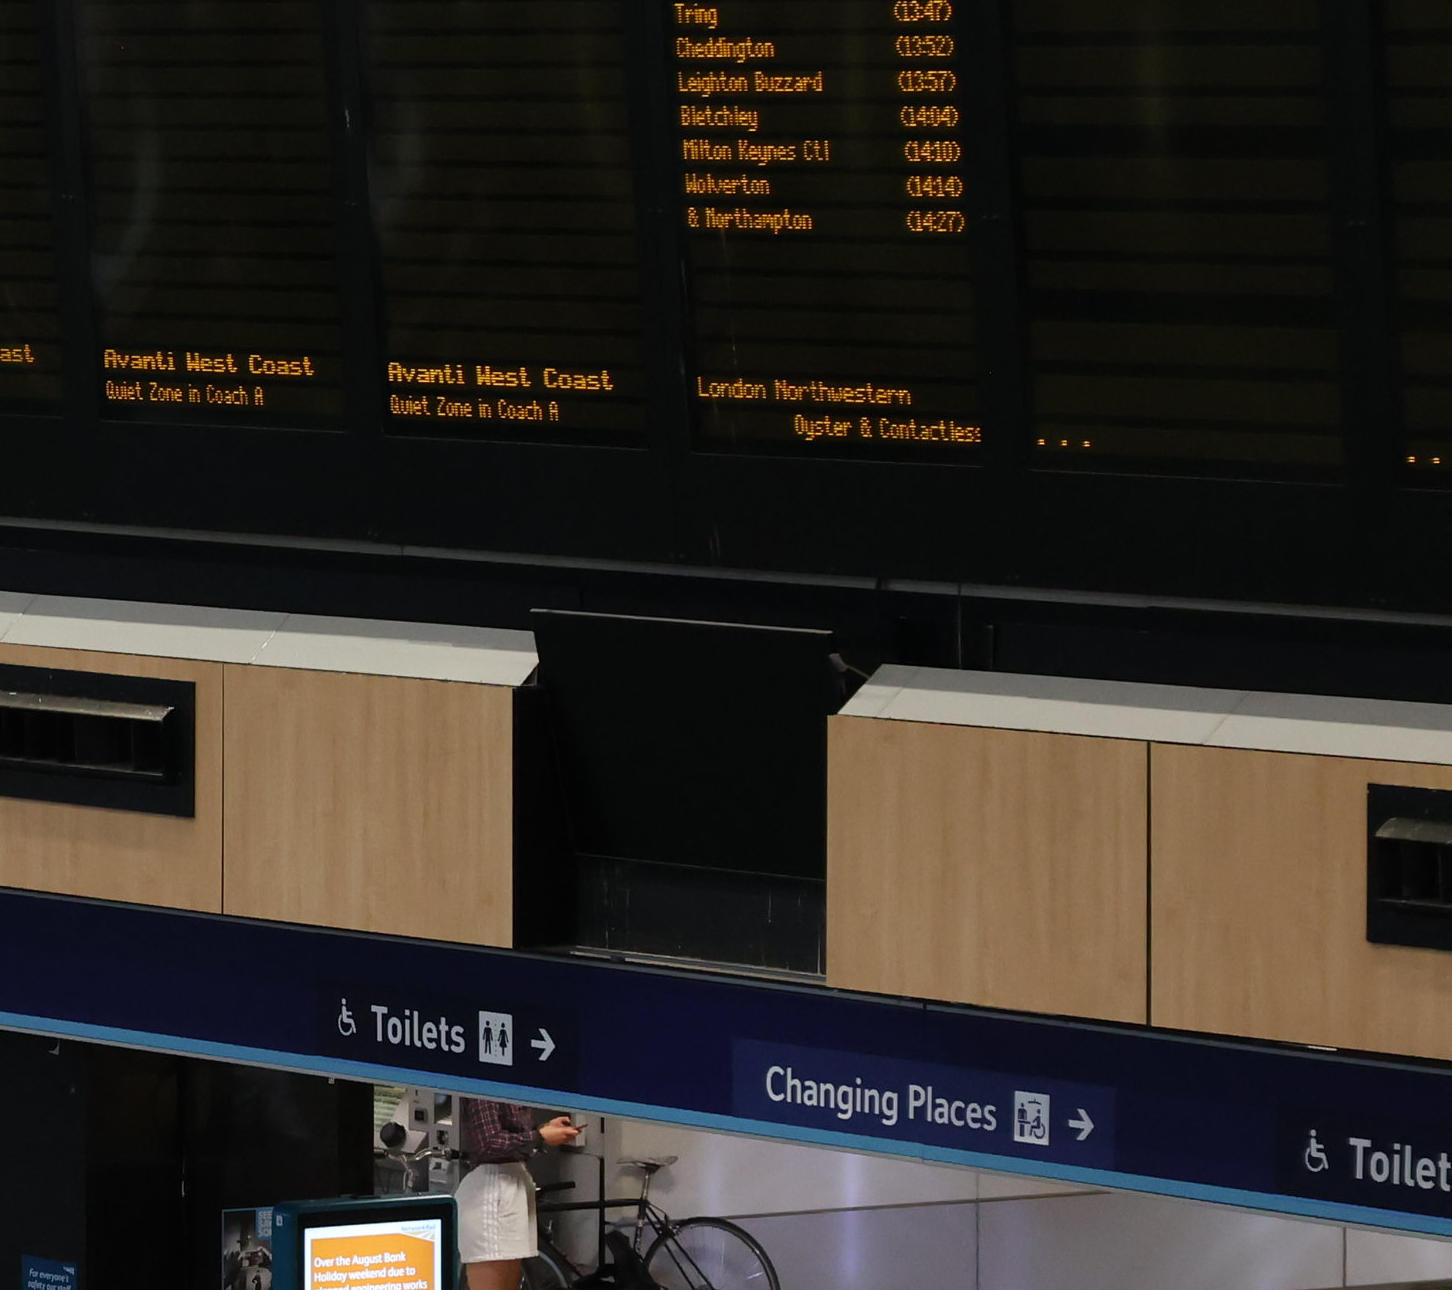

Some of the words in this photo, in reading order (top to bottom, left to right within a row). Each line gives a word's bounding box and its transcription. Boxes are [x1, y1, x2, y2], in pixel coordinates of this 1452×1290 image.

[674, 3, 718, 29] Tring
[894, 0, 952, 22] (13:47)
[388, 363, 464, 385] Avanti
[476, 365, 530, 388] West
[544, 368, 614, 391] Coast
[698, 376, 766, 400] London
[775, 380, 911, 405] Northwestern
[371, 1005, 465, 1053] Toilets
[766, 1065, 898, 1126] Changing
[909, 1084, 996, 1130] Places
[314, 1257, 334, 1267] Over
[336, 1256, 350, 1265] the
[352, 1254, 382, 1266] August
[384, 1252, 406, 1262] Bank
[314, 1272, 347, 1283] Holiday
[349, 1268, 386, 1279] weekend
[388, 1268, 404, 1277] due
[406, 1267, 415, 1276] to
[403, 1280, 427, 1290] works
